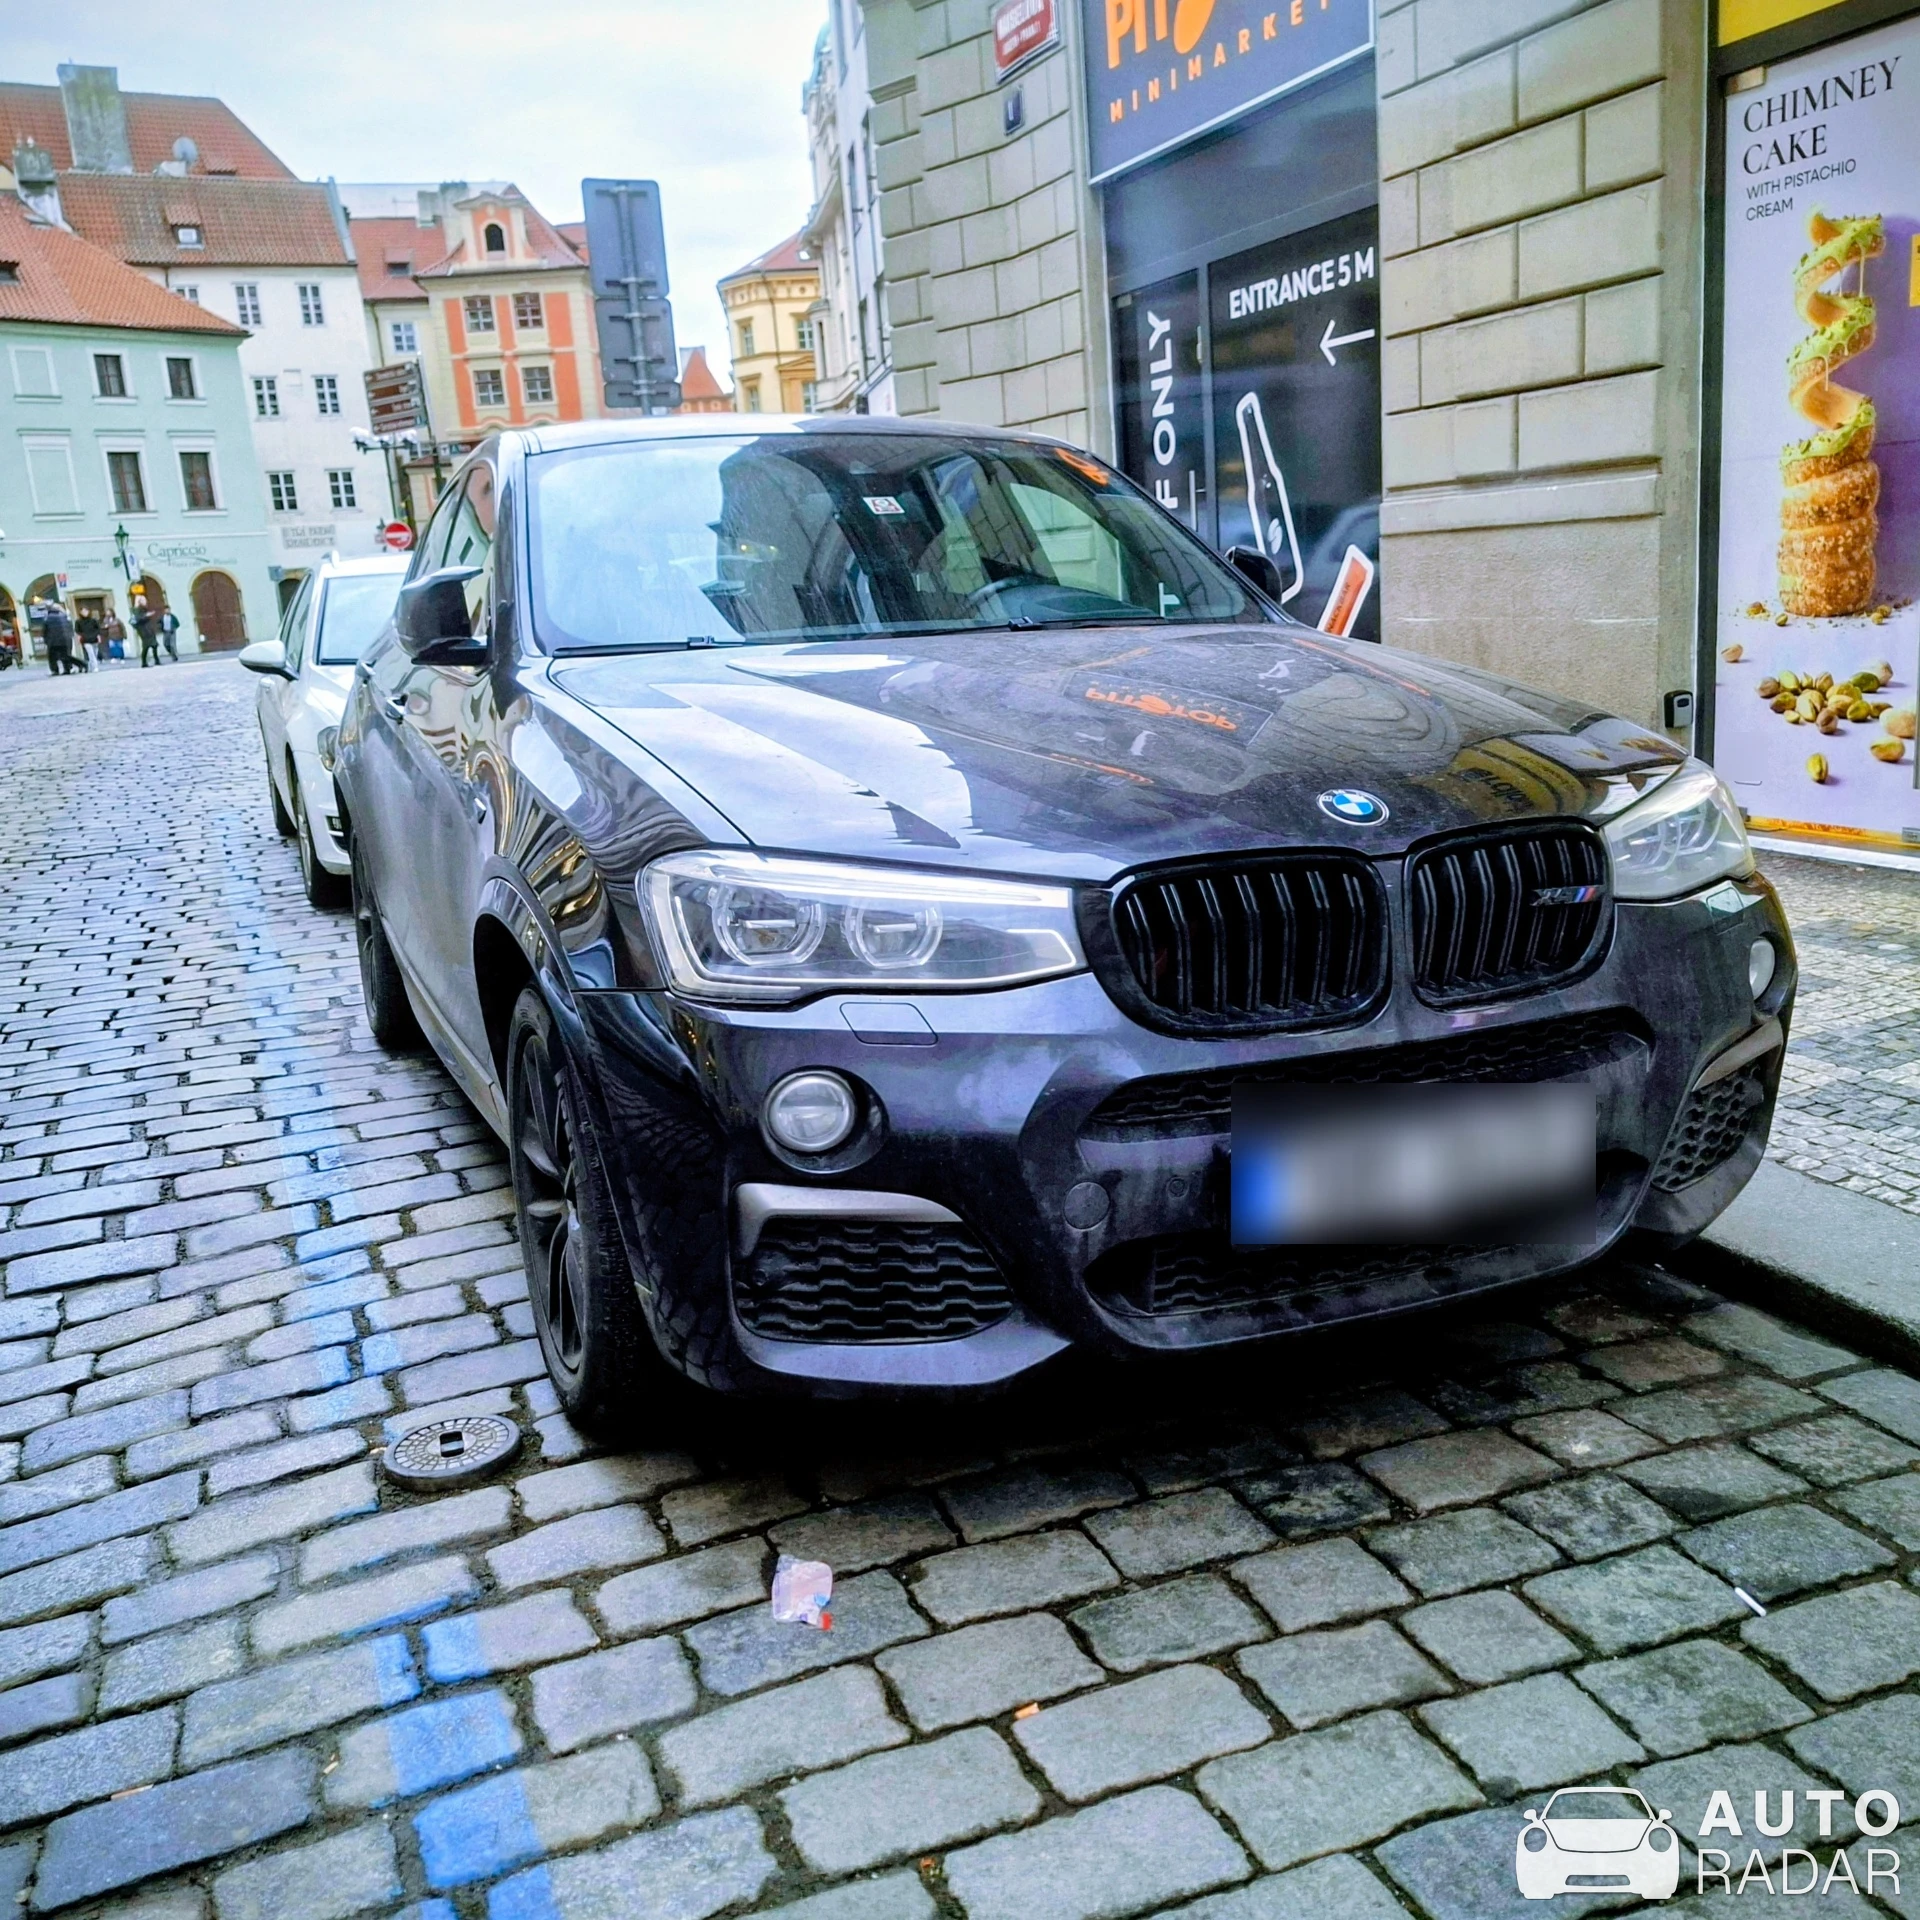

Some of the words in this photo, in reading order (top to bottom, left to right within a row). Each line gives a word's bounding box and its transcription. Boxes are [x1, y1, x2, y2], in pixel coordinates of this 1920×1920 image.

[1110, 0, 1328, 123] MINIMARKE
[1743, 56, 1902, 133] CHIMNEY
[1743, 124, 1828, 175] CAKE
[1746, 178, 1781, 200] WITH
[1784, 158, 1857, 190] PISTACHIO
[1746, 197, 1793, 221] CREAM
[1229, 259, 1336, 320] ENTRANCE
[1338, 254, 1352, 287] 5
[1354, 246, 1375, 283] M
[1147, 311, 1176, 466] ONLY
[147, 542, 207, 566] Capriccio
